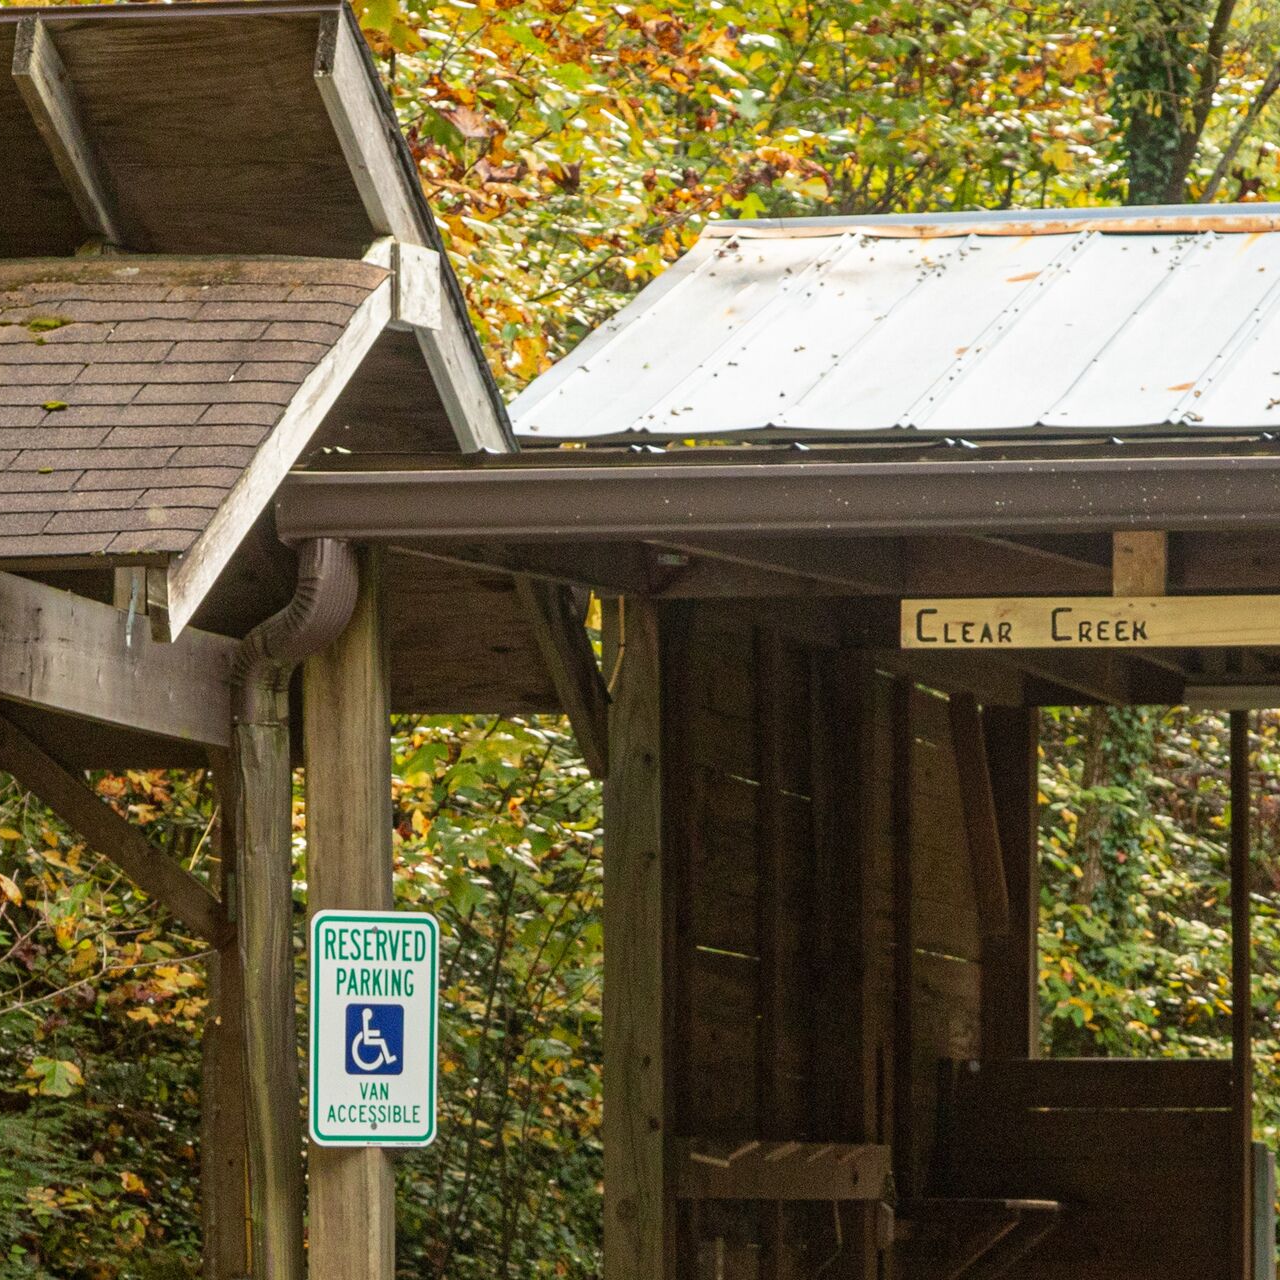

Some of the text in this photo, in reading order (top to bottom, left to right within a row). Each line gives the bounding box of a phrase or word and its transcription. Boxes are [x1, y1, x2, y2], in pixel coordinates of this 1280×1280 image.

[916, 607, 1148, 643] CLEAR CREEK
[325, 928, 426, 962] RESERVED
[336, 968, 414, 997] PARKING
[359, 1082, 389, 1100] VAN
[327, 1104, 421, 1123] ACCESSIBLE
